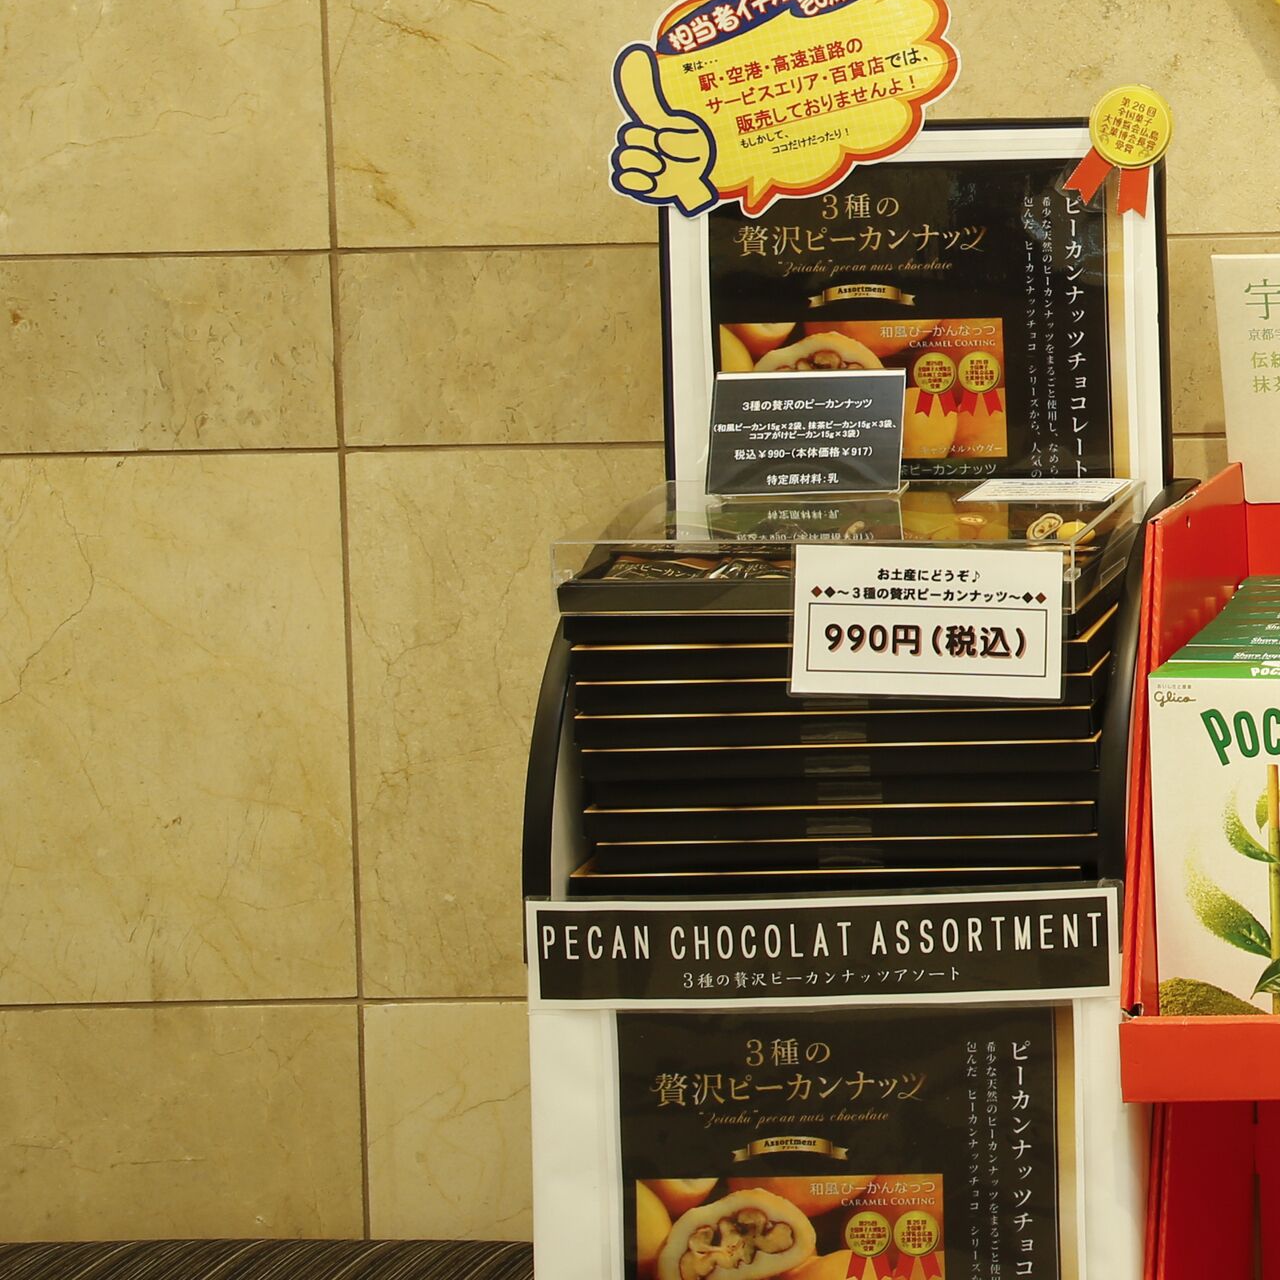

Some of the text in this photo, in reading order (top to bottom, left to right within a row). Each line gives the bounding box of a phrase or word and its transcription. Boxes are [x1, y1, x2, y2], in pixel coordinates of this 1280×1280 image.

[698, 37, 863, 93] 駅・空港・高速道路の
[736, 74, 916, 134] 販売しておりませんよ!
[822, 193, 900, 220] 3種の
[733, 222, 988, 257] 贅沢ピーカンナッツ
[837, 286, 886, 295] Assortment
[1154, 691, 1197, 707] Glico
[542, 912, 1102, 960] PECAN CHOCOLAT ASSORTMENT
[682, 966, 960, 989] 3種の贅沢ピーカンナッツアソート
[746, 1038, 831, 1067] 3種の
[650, 1071, 928, 1107] 贅沢ピーカンナッツ
[764, 1137, 817, 1147] Assortment
[890, 1197, 936, 1206] COATING
